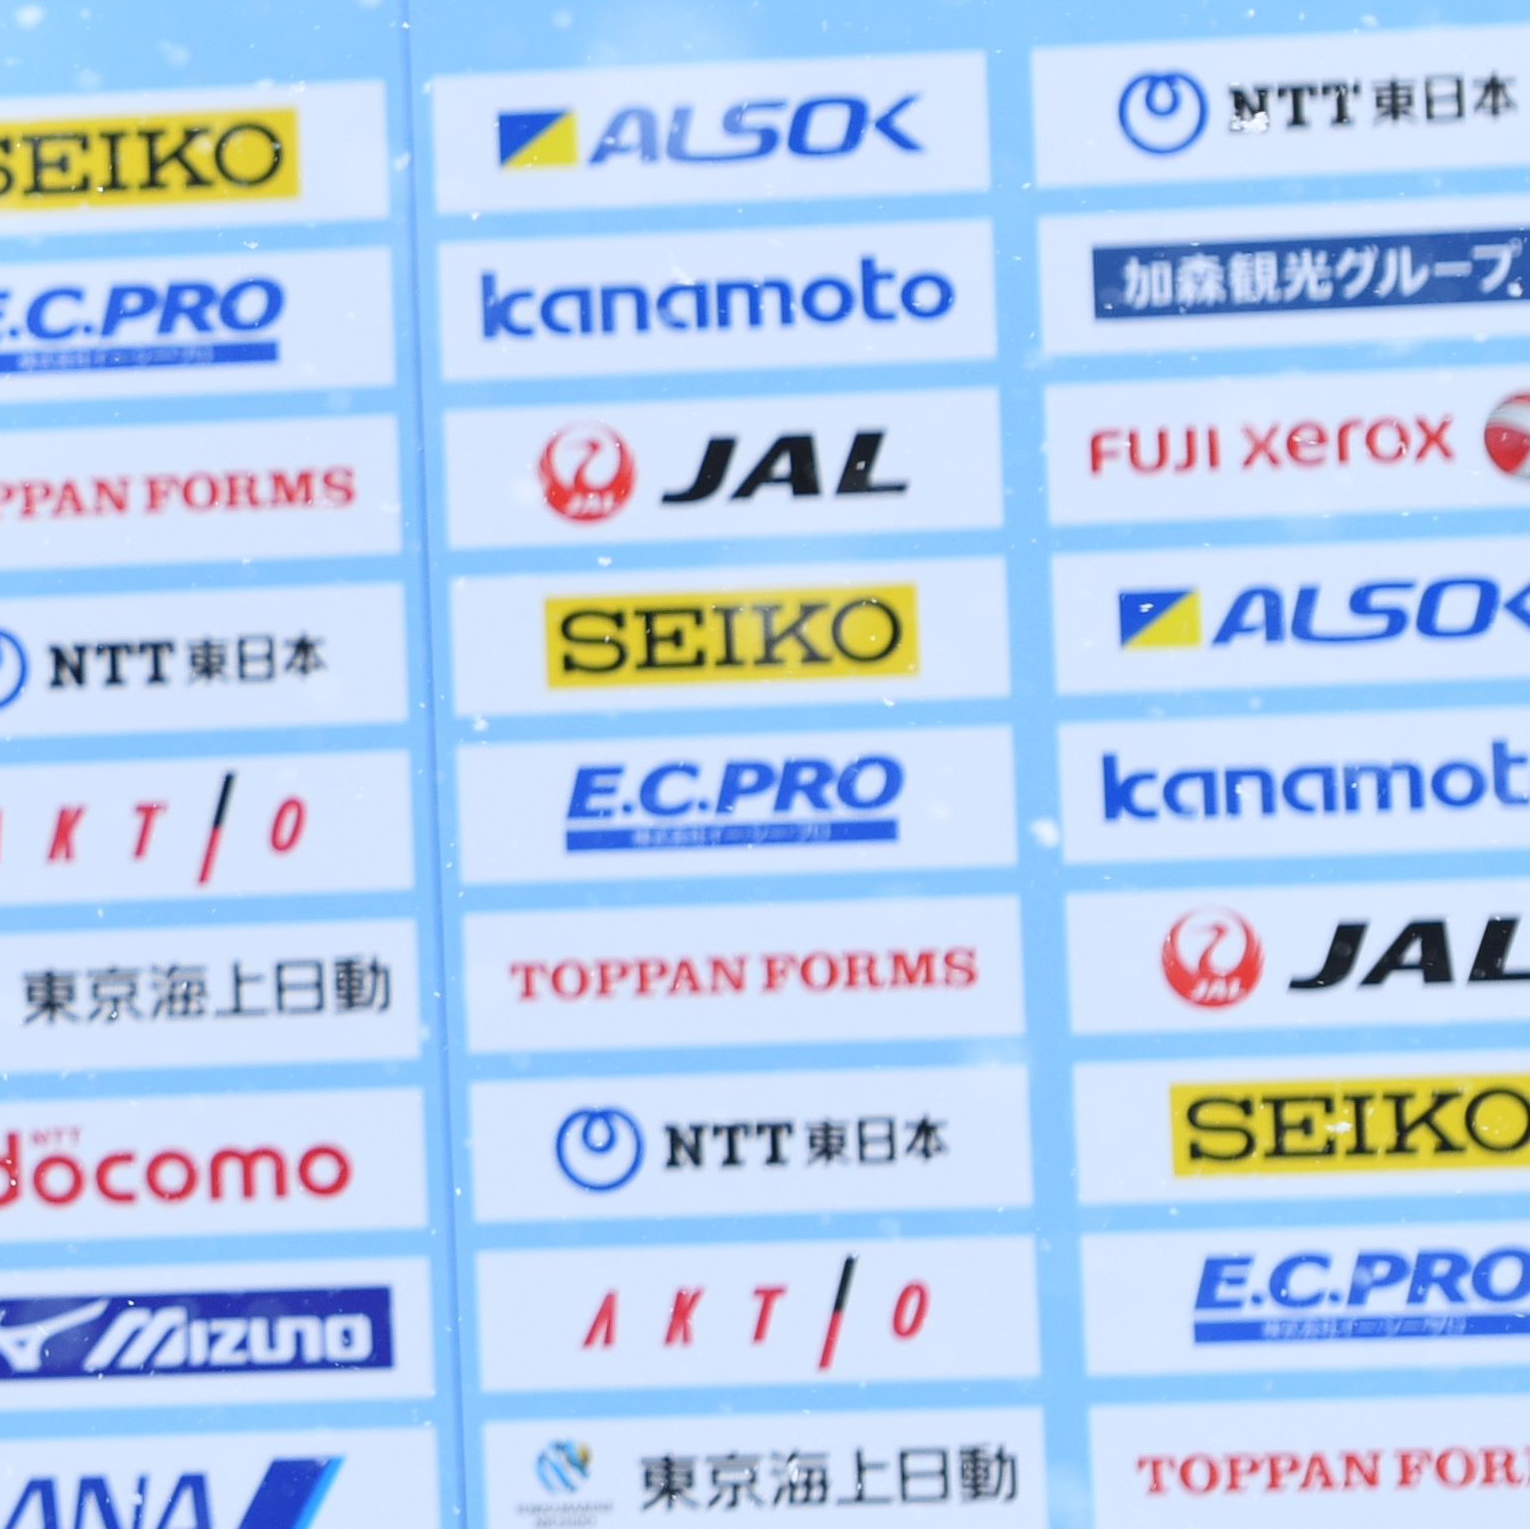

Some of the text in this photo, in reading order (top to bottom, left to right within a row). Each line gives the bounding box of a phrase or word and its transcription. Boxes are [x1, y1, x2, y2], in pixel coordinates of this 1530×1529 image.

[589, 95, 923, 165] ALSOK
[1228, 74, 1513, 129] NTT東日本
[480, 255, 956, 340] kanamoto
[1122, 239, 1527, 311] 加森観光グループ
[660, 430, 908, 505] JAL
[1089, 417, 1454, 475] FUJI xerox
[143, 466, 356, 513] FORMS
[48, 634, 322, 689] NTT東日本
[559, 599, 903, 675] SEIKO
[565, 755, 906, 817] E.C.PRO
[510, 947, 979, 1001] TOPPAN FORMS
[1288, 916, 1530, 992] JAL
[24, 956, 391, 1024] 東京海上日動
[664, 1116, 944, 1169] NTT東日本
[1186, 1087, 1530, 1163] SEIKO
[1194, 1250, 1530, 1310] E.C.PRO
[641, 1445, 1018, 1510] 東京海上日動
[1138, 1452, 1382, 1494] TOPPAN
